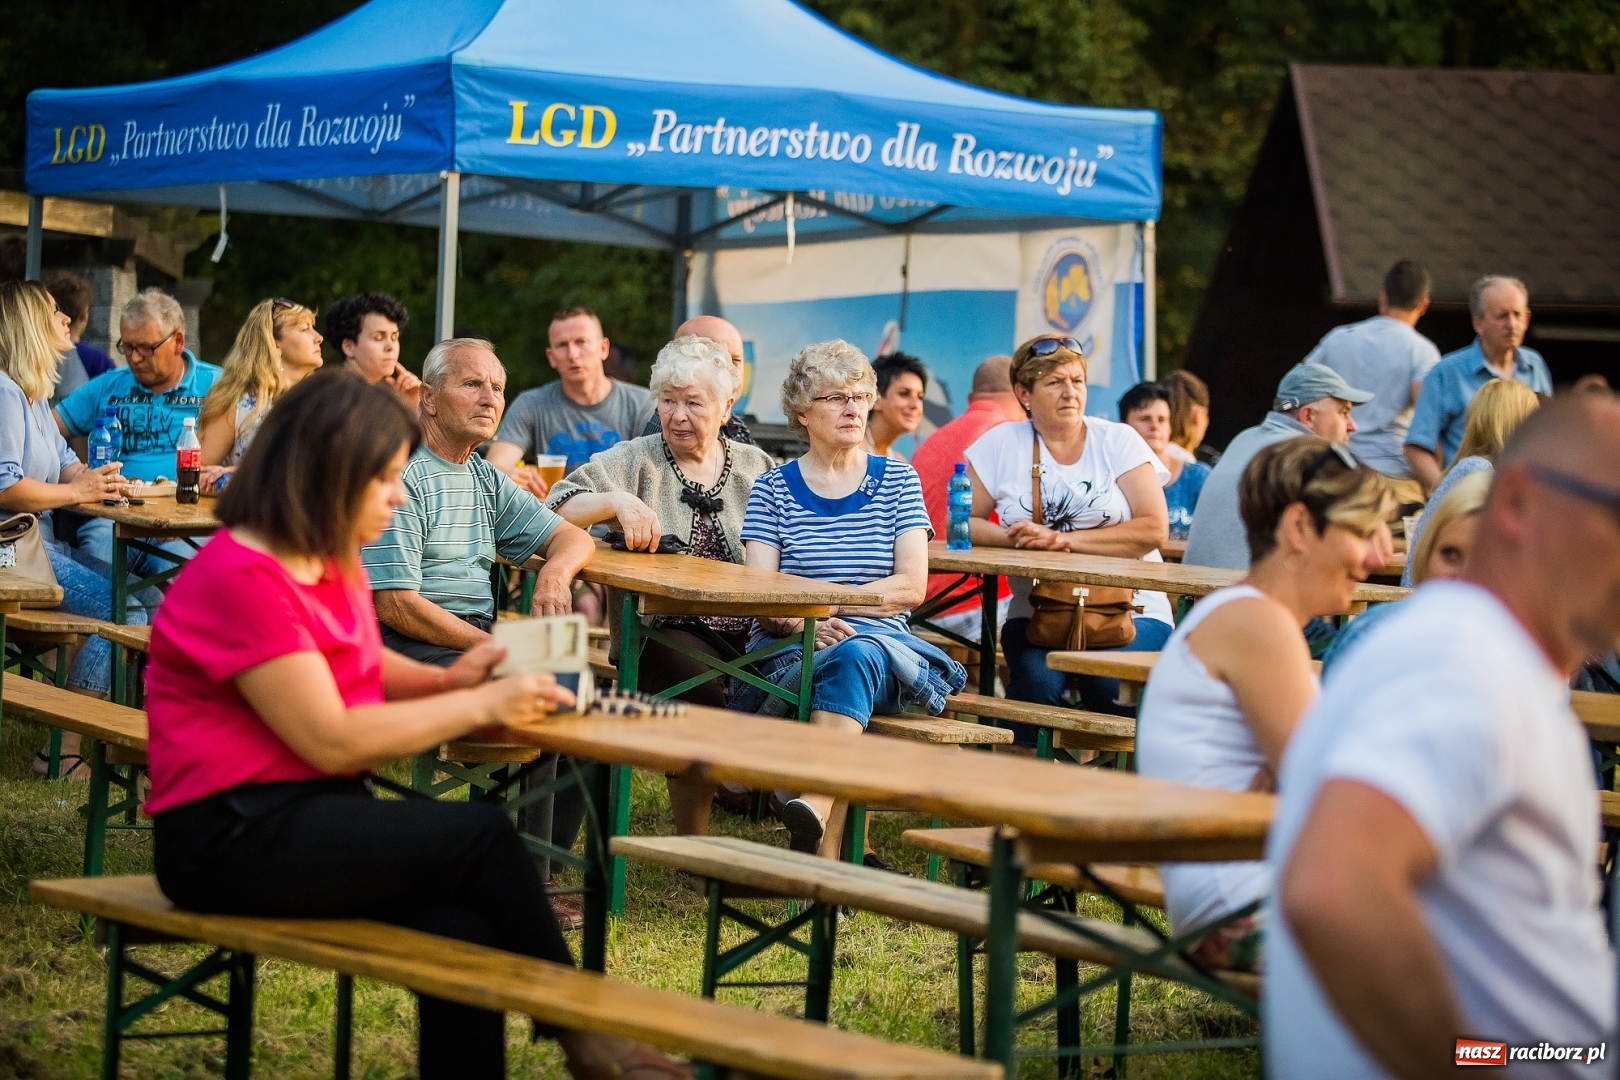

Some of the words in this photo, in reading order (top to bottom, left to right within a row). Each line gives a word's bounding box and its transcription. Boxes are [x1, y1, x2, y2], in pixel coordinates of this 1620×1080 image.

[51, 124, 106, 164] LGD
[255, 102, 292, 149] dla
[505, 101, 617, 149] LGD
[626, 109, 872, 164] „Partnerstwo
[881, 121, 939, 172] dla
[948, 132, 1114, 196] Rozwoju”
